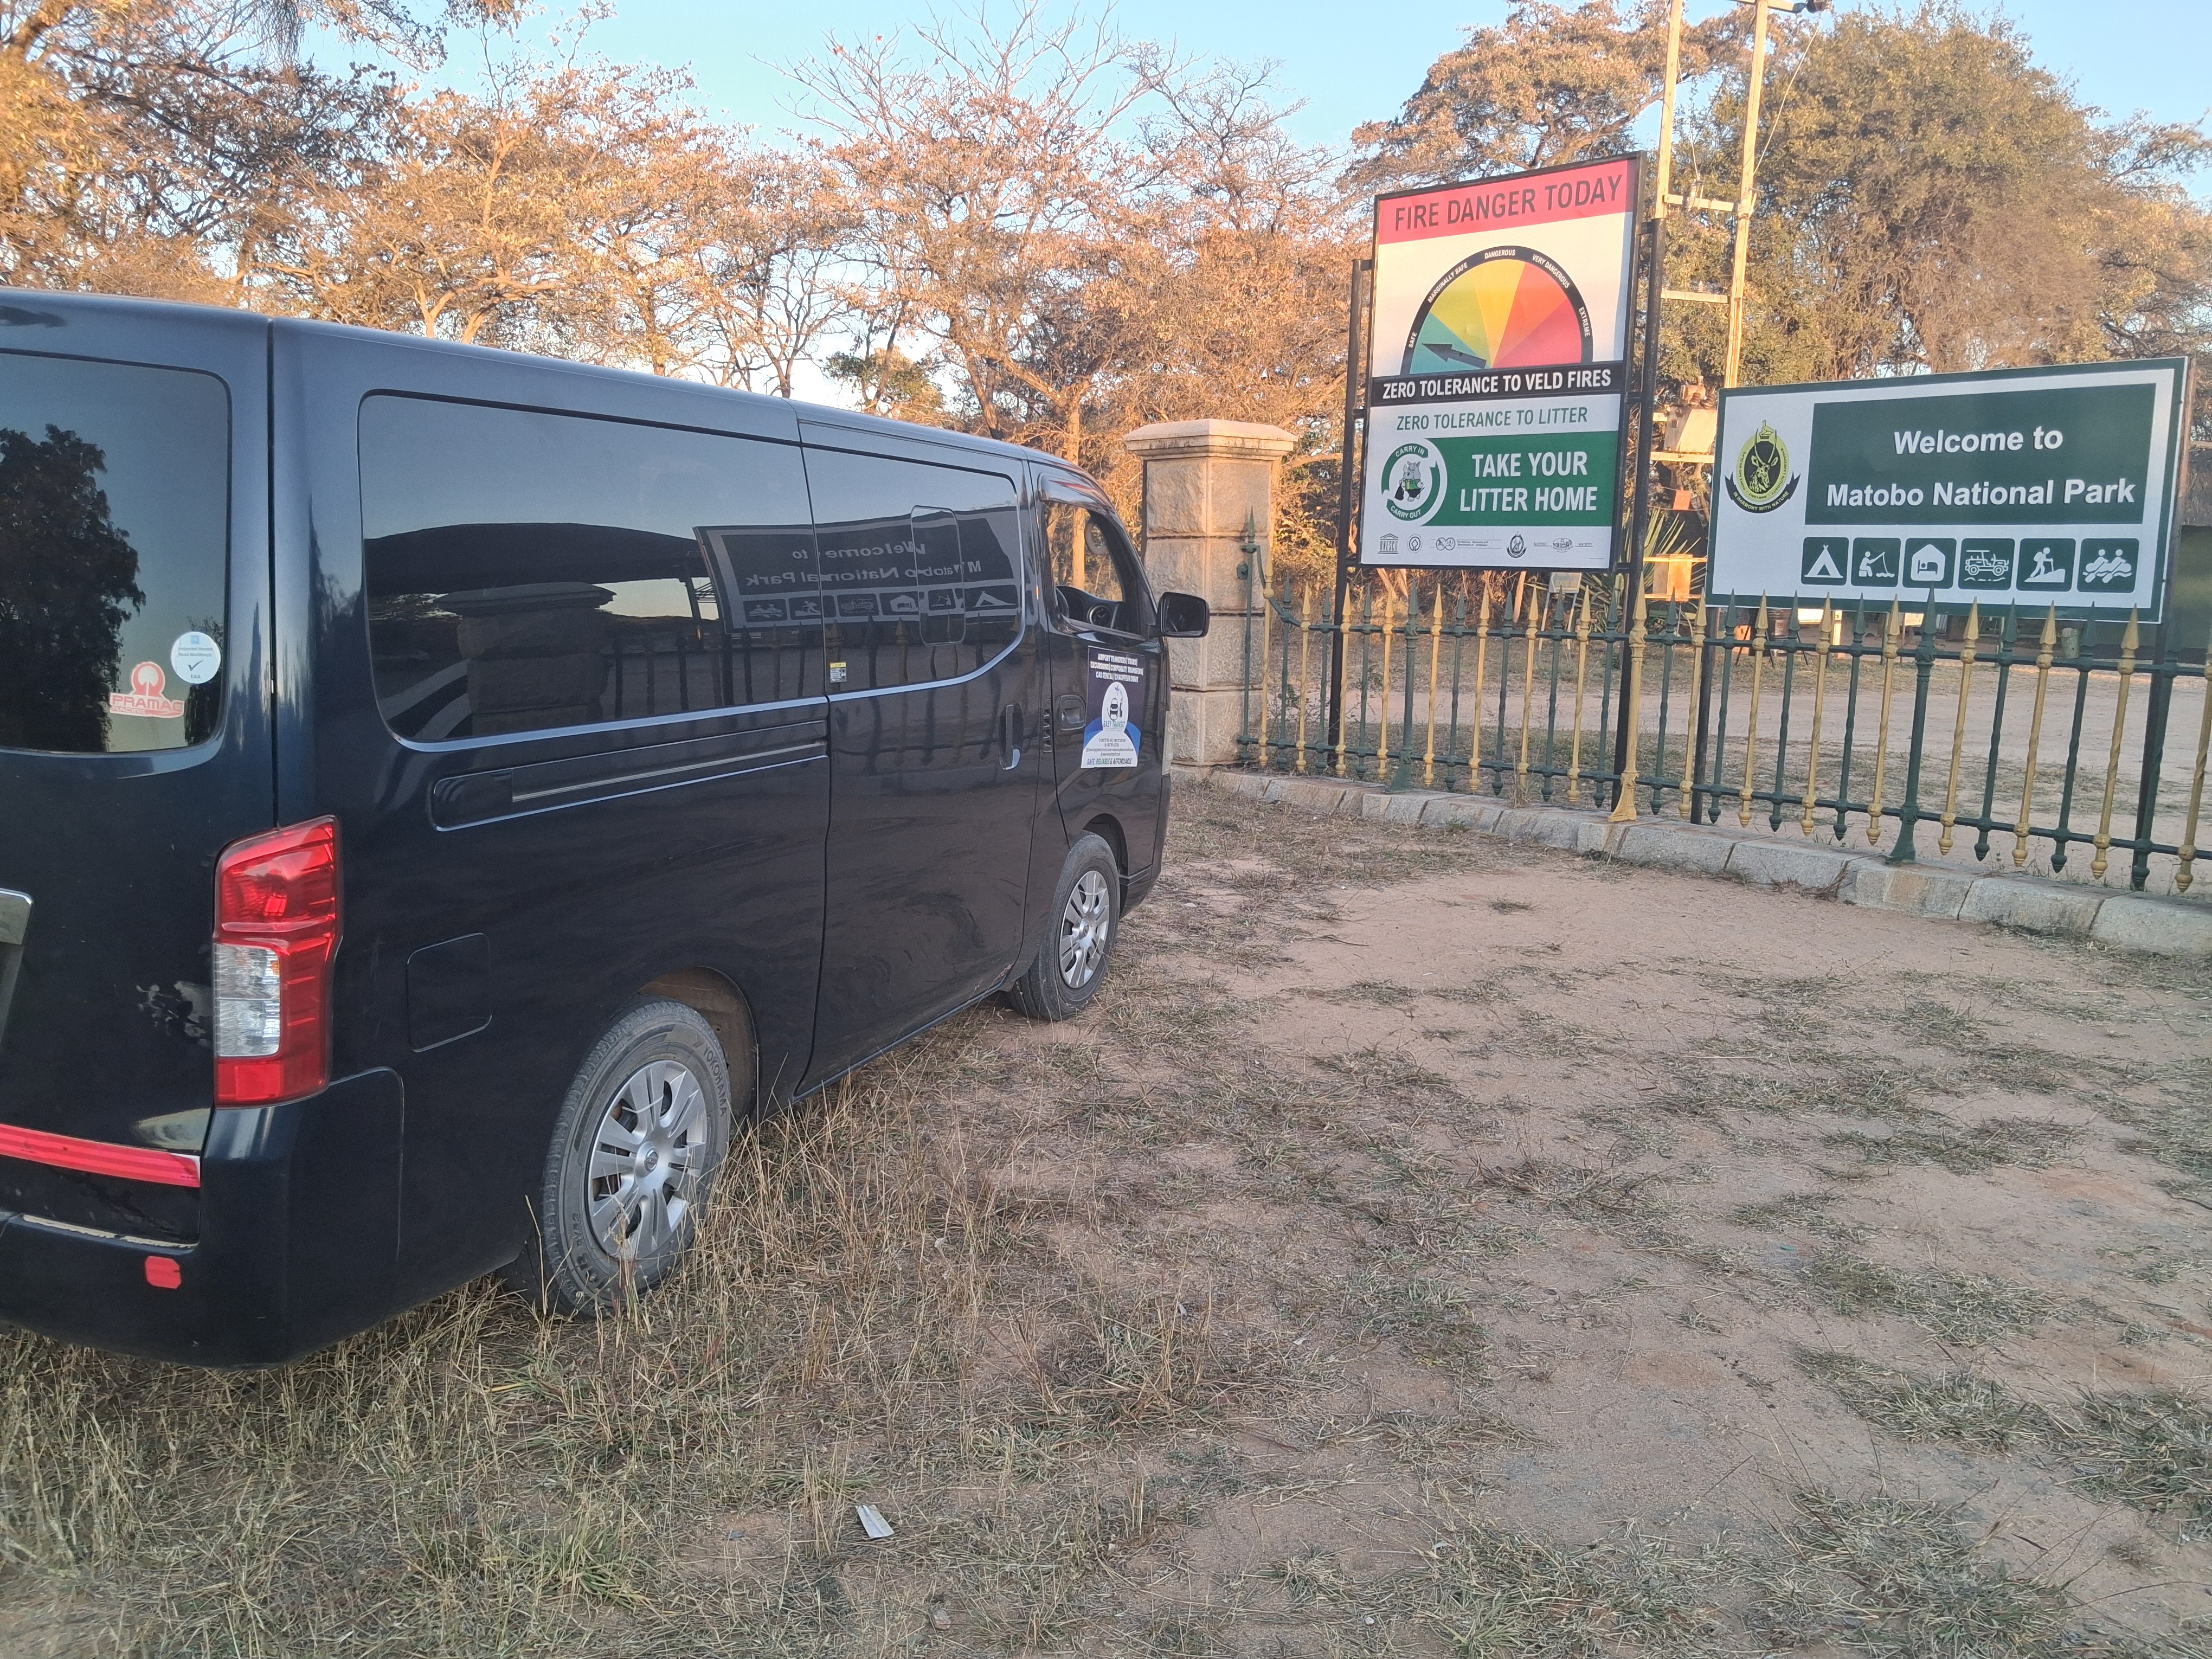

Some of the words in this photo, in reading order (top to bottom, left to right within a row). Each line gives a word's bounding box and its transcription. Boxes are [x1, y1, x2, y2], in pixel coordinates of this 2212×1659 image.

[1396, 202, 1439, 231] FIRE
[1448, 189, 1536, 224] DANGER
[1545, 174, 1623, 210] TODAY
[1484, 249, 1515, 259] DANGEROUS
[1427, 271, 1455, 303] MARGINALLY
[1455, 262, 1468, 274] SAFE
[1532, 254, 1546, 265] VERY
[1544, 261, 1570, 289] DANGEROUS
[1578, 307, 1591, 337] EXTREME
[1409, 332, 1417, 348] SAFE
[1382, 382, 1415, 400] ZERO
[1419, 376, 1498, 396] TOLERANCE
[1502, 374, 1521, 392] TO
[1525, 371, 1562, 391] VELD
[1567, 369, 1611, 388] FIRES
[1396, 414, 1429, 431] ZERO
[1433, 410, 1512, 429] TOLERANCE
[1516, 409, 1534, 425] TO
[1539, 407, 1588, 425] LITTER
[1395, 445, 1417, 458] CARRY
[1418, 446, 1425, 455] IN
[1894, 429, 2024, 454] Welcome
[2033, 426, 2063, 450] to
[1471, 453, 1521, 478] TAKE
[1528, 451, 1587, 477] YOUR
[1459, 487, 1528, 511] LITTER
[1534, 486, 1598, 511] HOME
[1737, 497, 1758, 511] HARMONY
[1771, 491, 1789, 507] NATURE
[1827, 483, 1924, 507] Matobo
[1932, 479, 2054, 506] National
[2063, 478, 2137, 504] Park
[1390, 505, 1409, 519] CARRY
[1409, 509, 1422, 518] OUT
[1380, 541, 1398, 551] UNESCO
[112, 706, 146, 714] RACING
[113, 695, 183, 712] PRAMAC
[703, 1044, 726, 1117] YOKOHAMA
